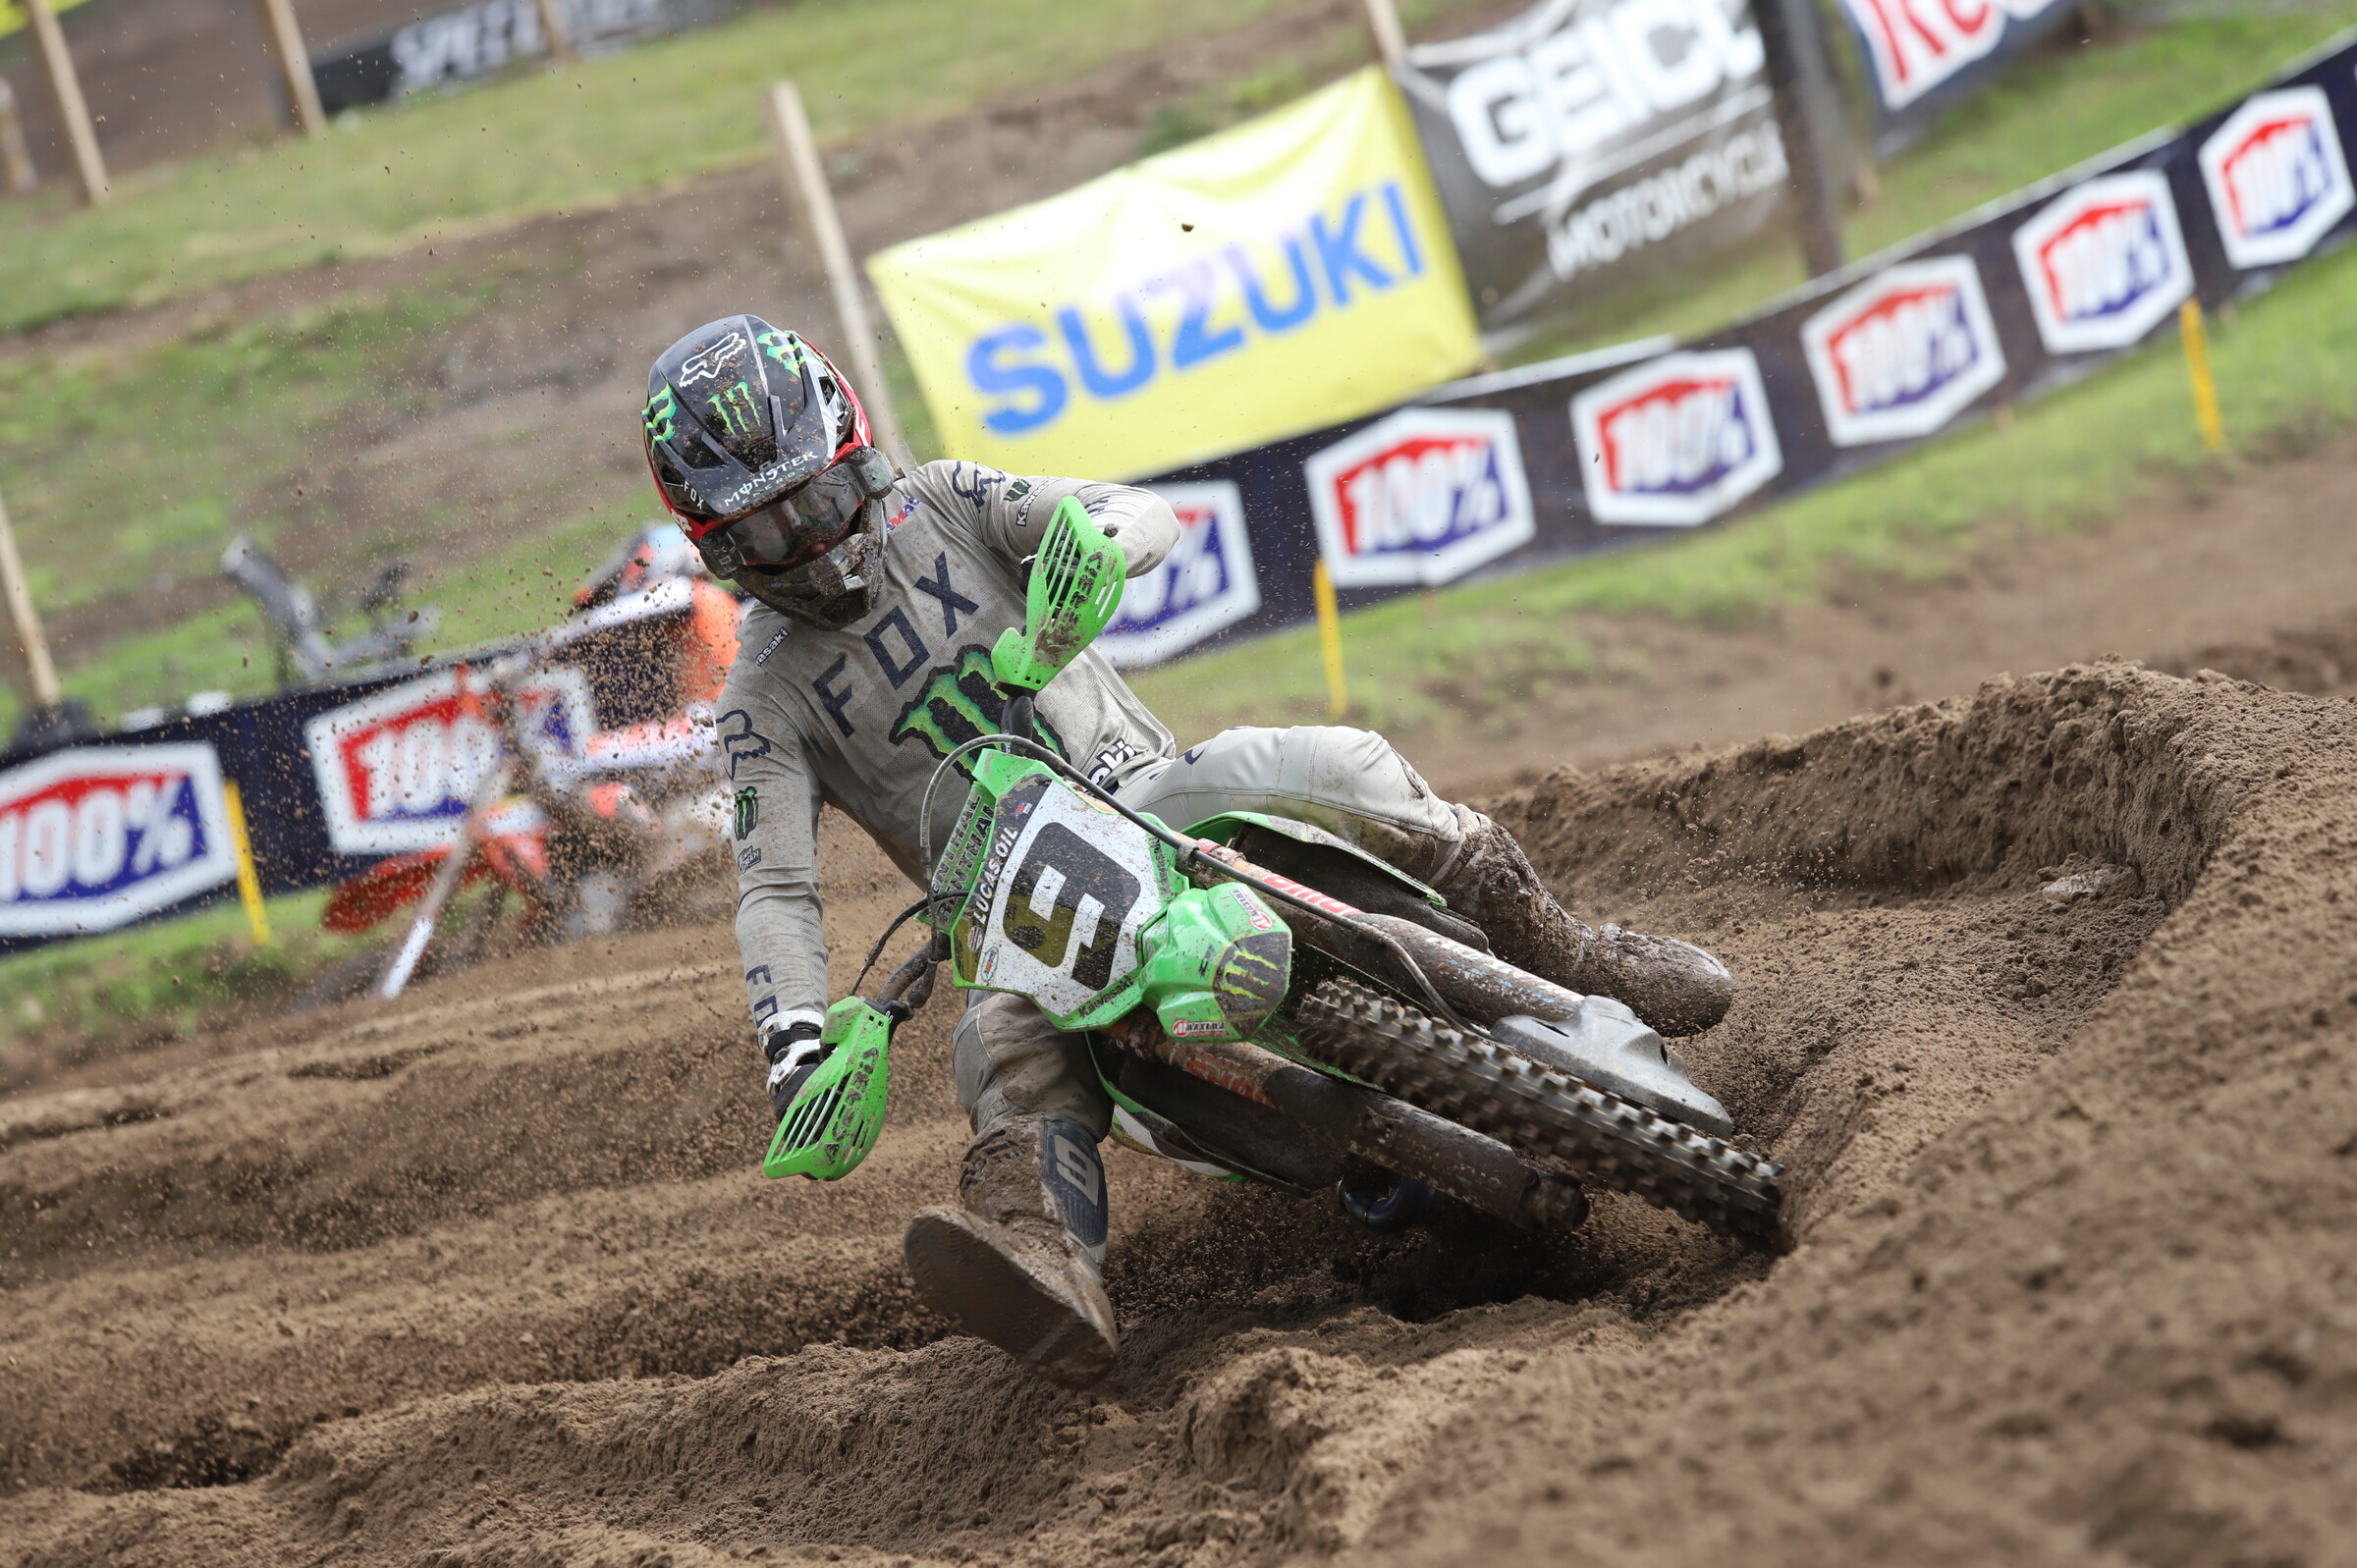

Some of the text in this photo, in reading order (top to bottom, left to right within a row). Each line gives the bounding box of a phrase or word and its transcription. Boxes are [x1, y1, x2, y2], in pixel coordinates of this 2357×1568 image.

[1547, 120, 1788, 281] MOTORCYCL
[966, 181, 1424, 438] SUZUKI
[1607, 384, 1749, 492] 100%
[683, 479, 704, 511] FOX
[1344, 441, 1502, 550] 100%
[811, 551, 979, 738] FOX
[932, 795, 982, 893] ENTHAL
[973, 858, 1002, 925] LUCAS
[995, 828, 1018, 859] OIL
[1002, 821, 1142, 993] 9
[746, 964, 779, 1029] FO
